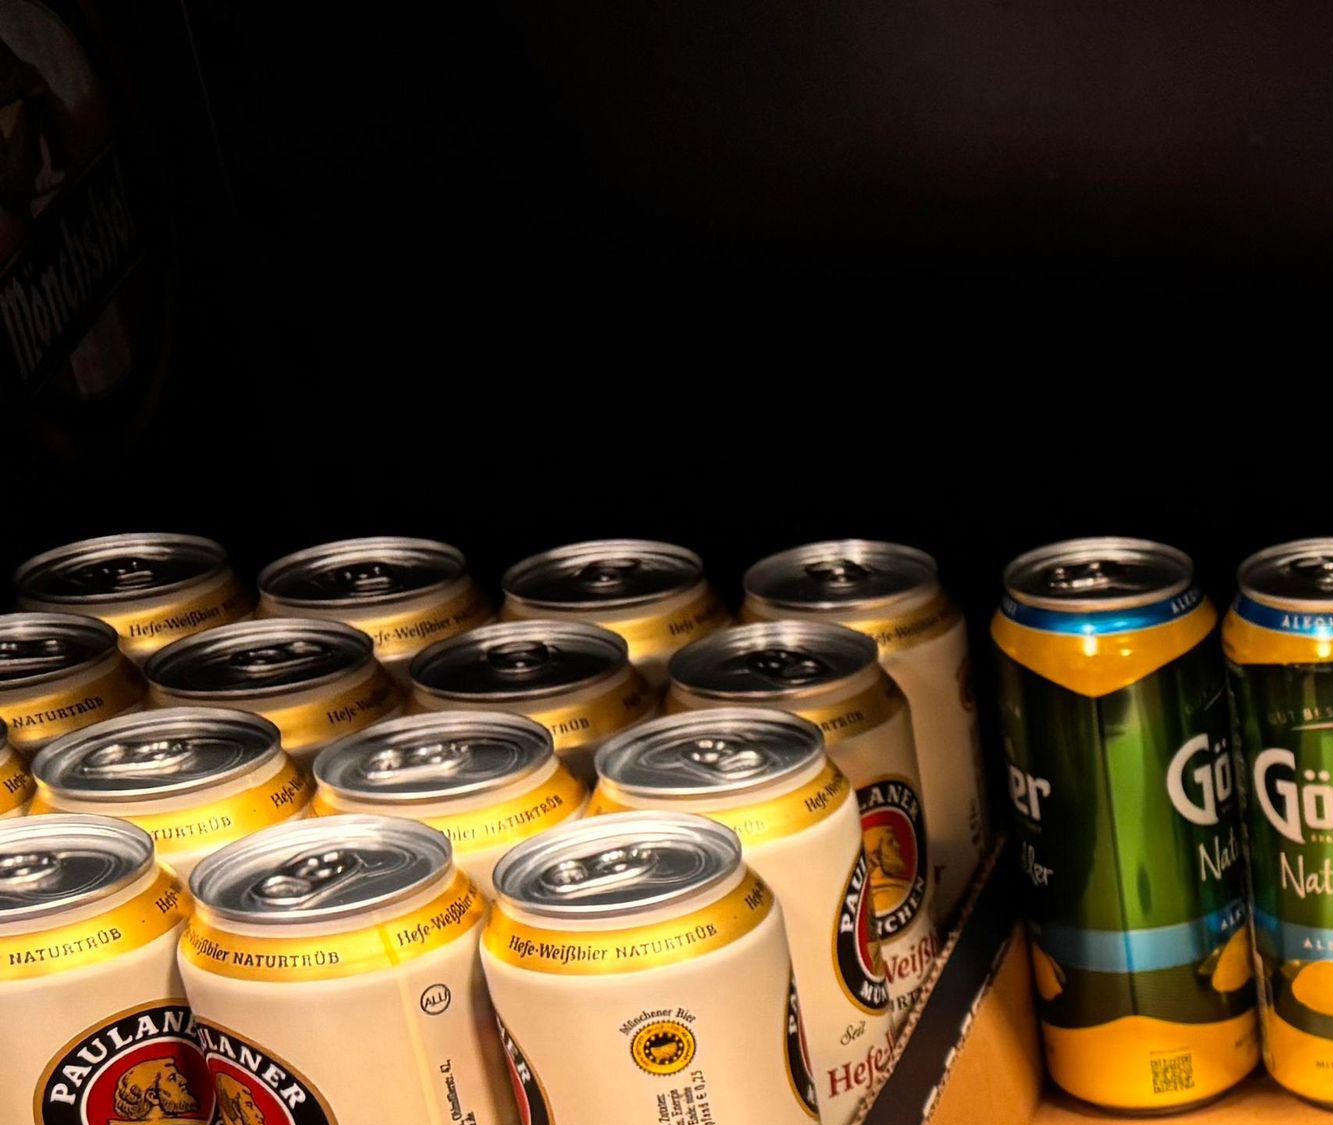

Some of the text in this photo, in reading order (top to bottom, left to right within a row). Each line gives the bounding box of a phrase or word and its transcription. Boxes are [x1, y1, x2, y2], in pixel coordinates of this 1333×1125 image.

[9, 928, 123, 966] NATURTRÜB
[508, 922, 719, 965] Hefe-Weißbier NATURTRÜB
[232, 950, 339, 970] NATURTRÜB
[675, 1008, 696, 1023] Bier
